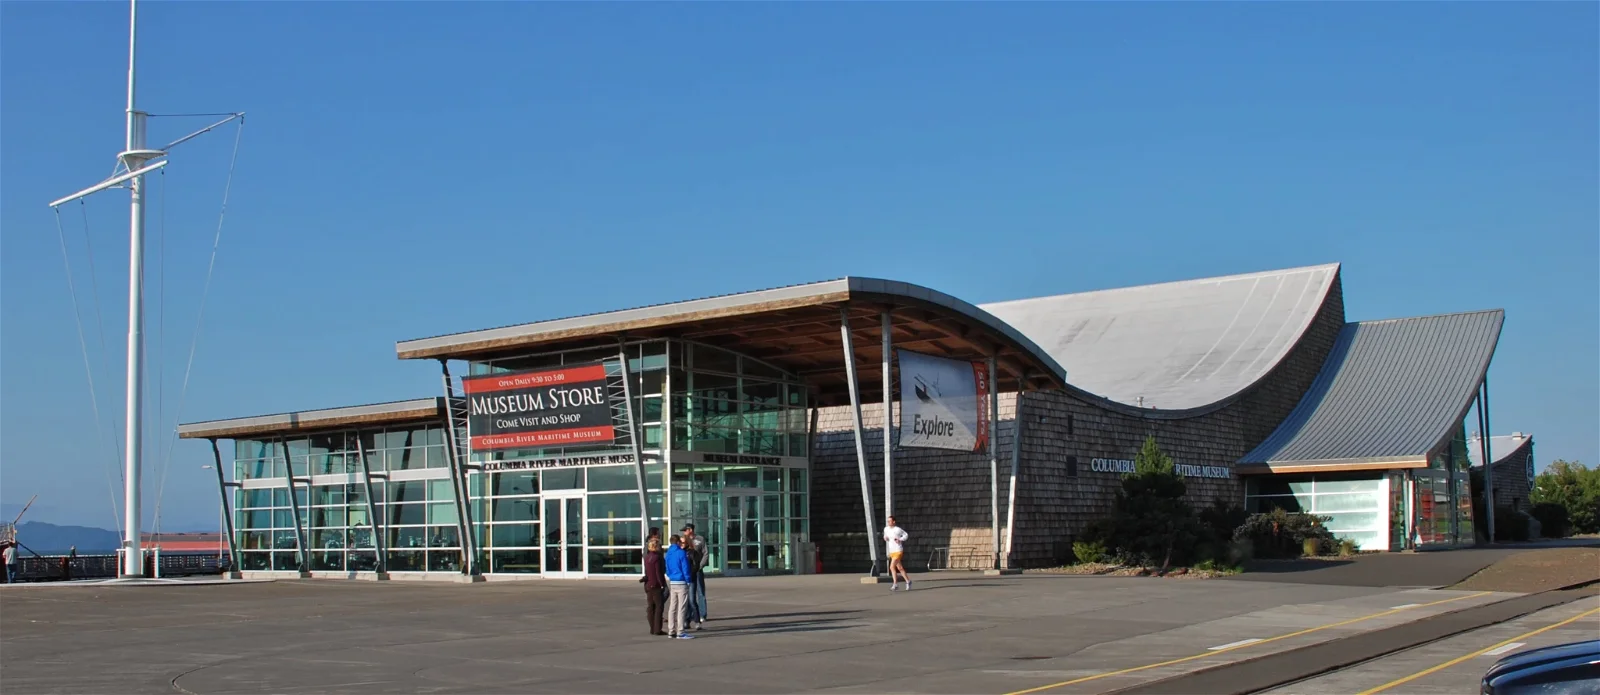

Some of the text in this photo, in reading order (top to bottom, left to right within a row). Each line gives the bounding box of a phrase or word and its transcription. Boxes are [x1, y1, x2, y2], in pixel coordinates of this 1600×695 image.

[498, 379, 514, 387] OPEN
[515, 377, 531, 385] DAILY
[531, 374, 543, 383] 9:30
[553, 373, 565, 381] 5:00
[471, 386, 605, 416] MUSEUM STORE
[496, 413, 581, 429] COME VISIT AND SHOP
[913, 413, 954, 440] Explore
[482, 430, 602, 445] COLUMBIA RIVER MARITIME MUSEUM
[484, 453, 637, 471] COLUMBIA RIVER MARITIME MUSE
[1091, 457, 1230, 478] COLUMBIA RITIME MUSEUM
